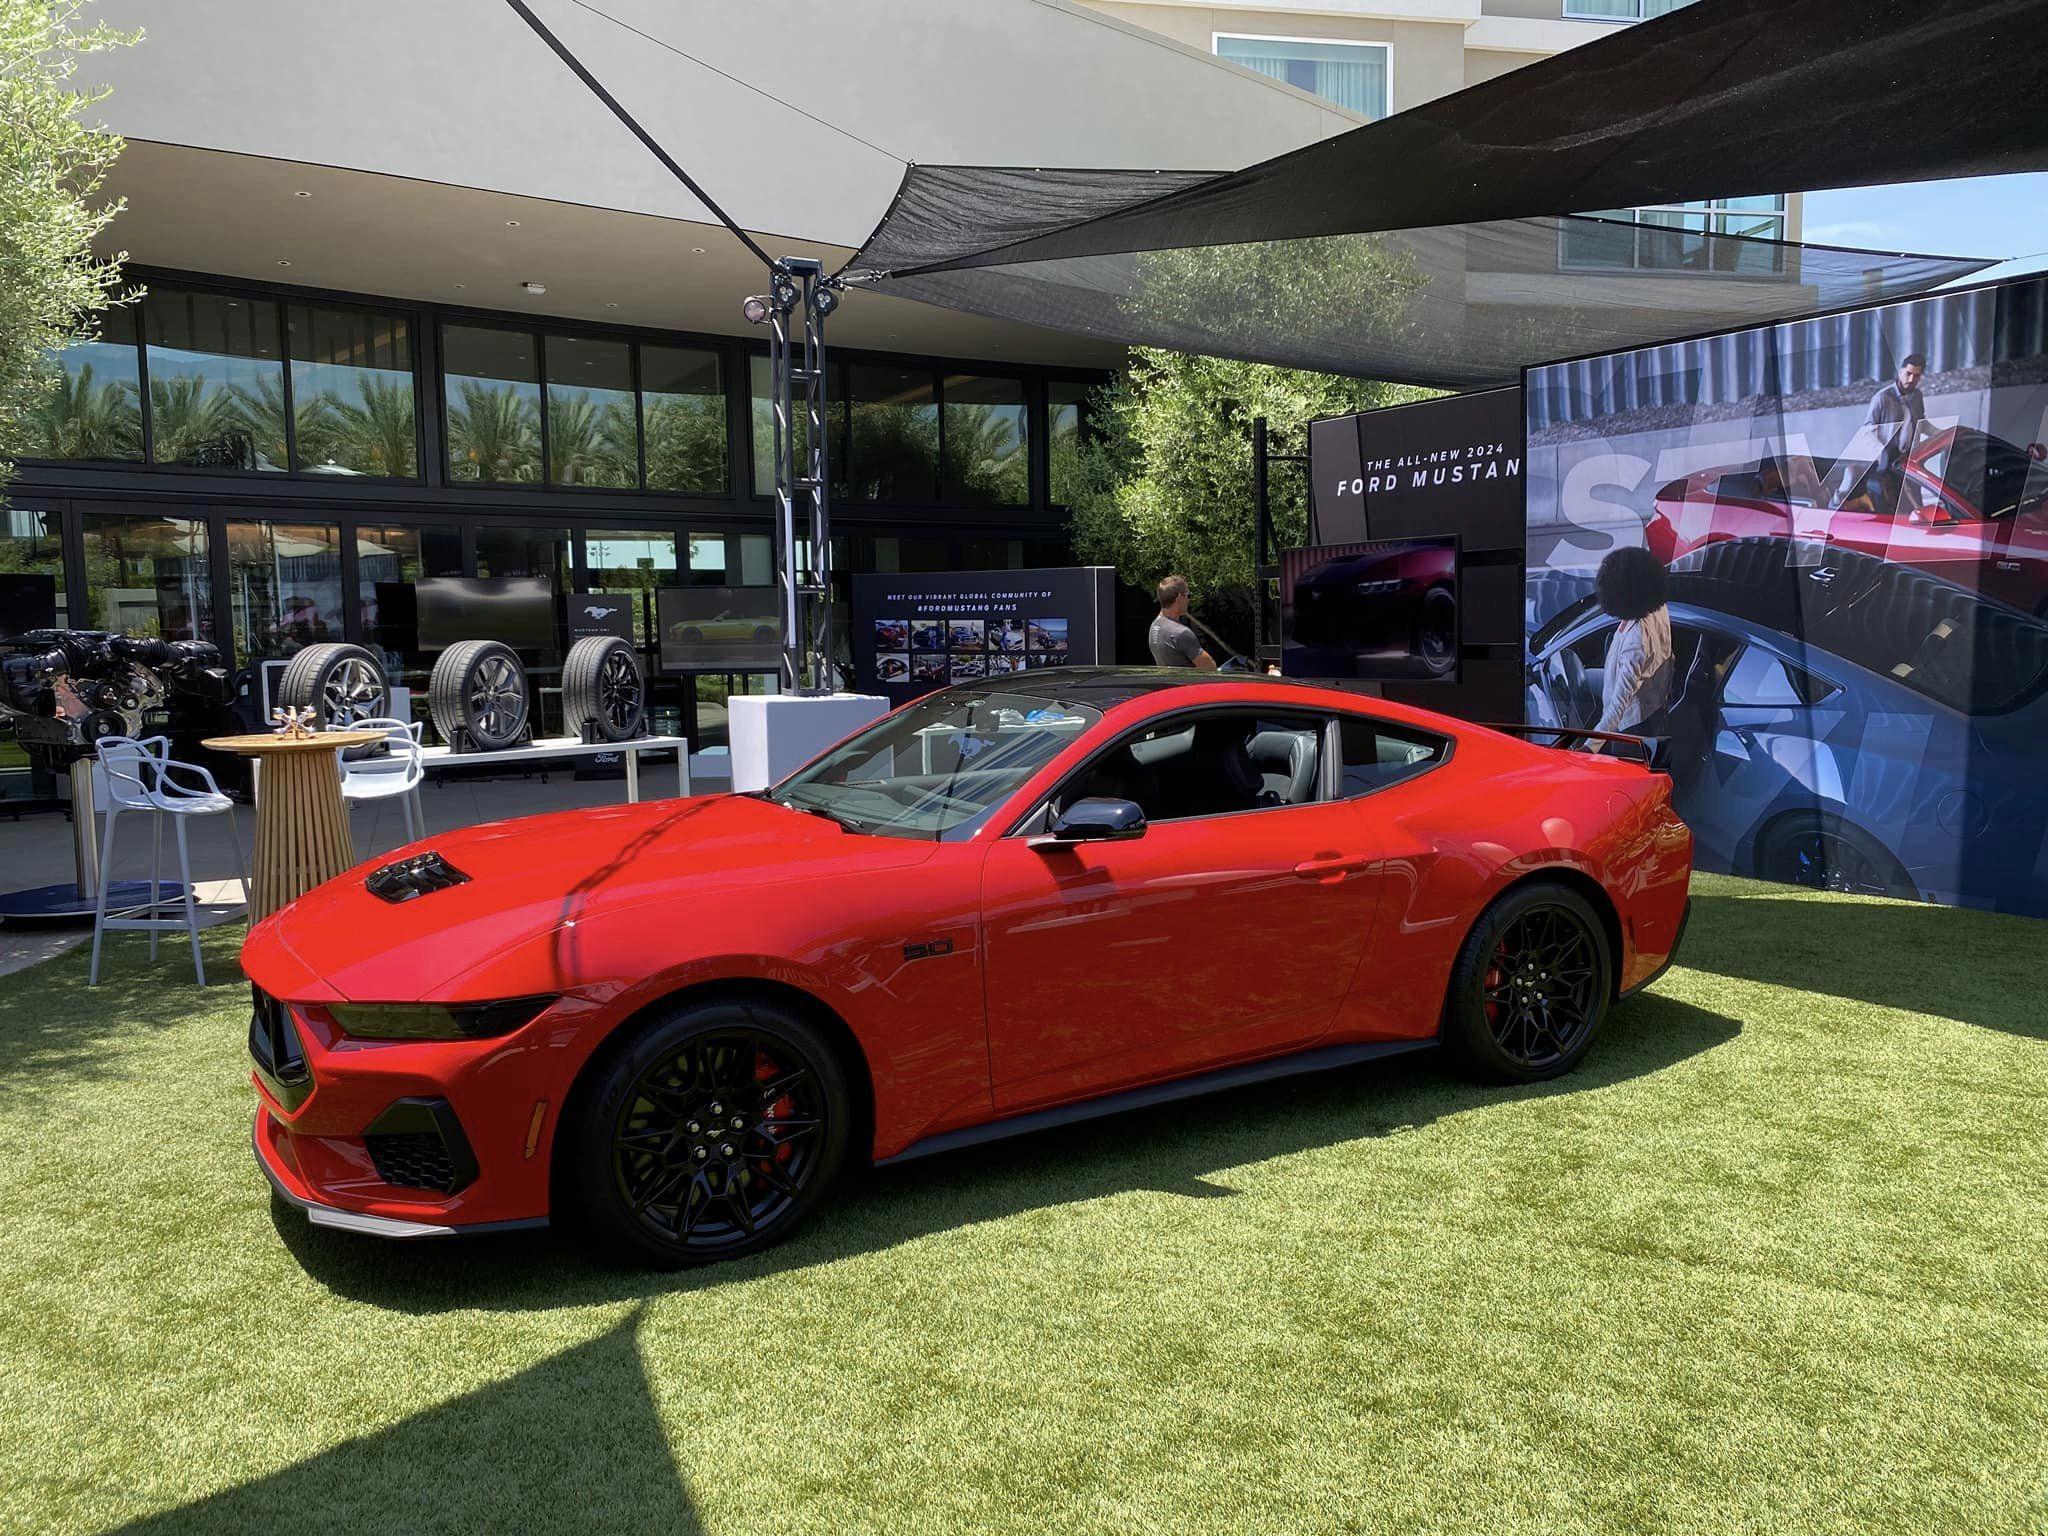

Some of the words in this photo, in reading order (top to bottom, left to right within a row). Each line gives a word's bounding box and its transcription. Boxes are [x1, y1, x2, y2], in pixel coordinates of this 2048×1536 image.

[1367, 458, 1391, 471] THE
[1397, 449, 1460, 468] ALL-NEW
[1467, 442, 1503, 458] 2024
[1337, 474, 1397, 497] FORD
[1412, 457, 1520, 488] MUSTAN
[907, 593, 923, 601] OUR
[925, 593, 957, 601] VIBRANT
[959, 592, 988, 600] GLOBAL
[991, 591, 1038, 599] COMMUNITY
[993, 603, 1017, 611] FANS
